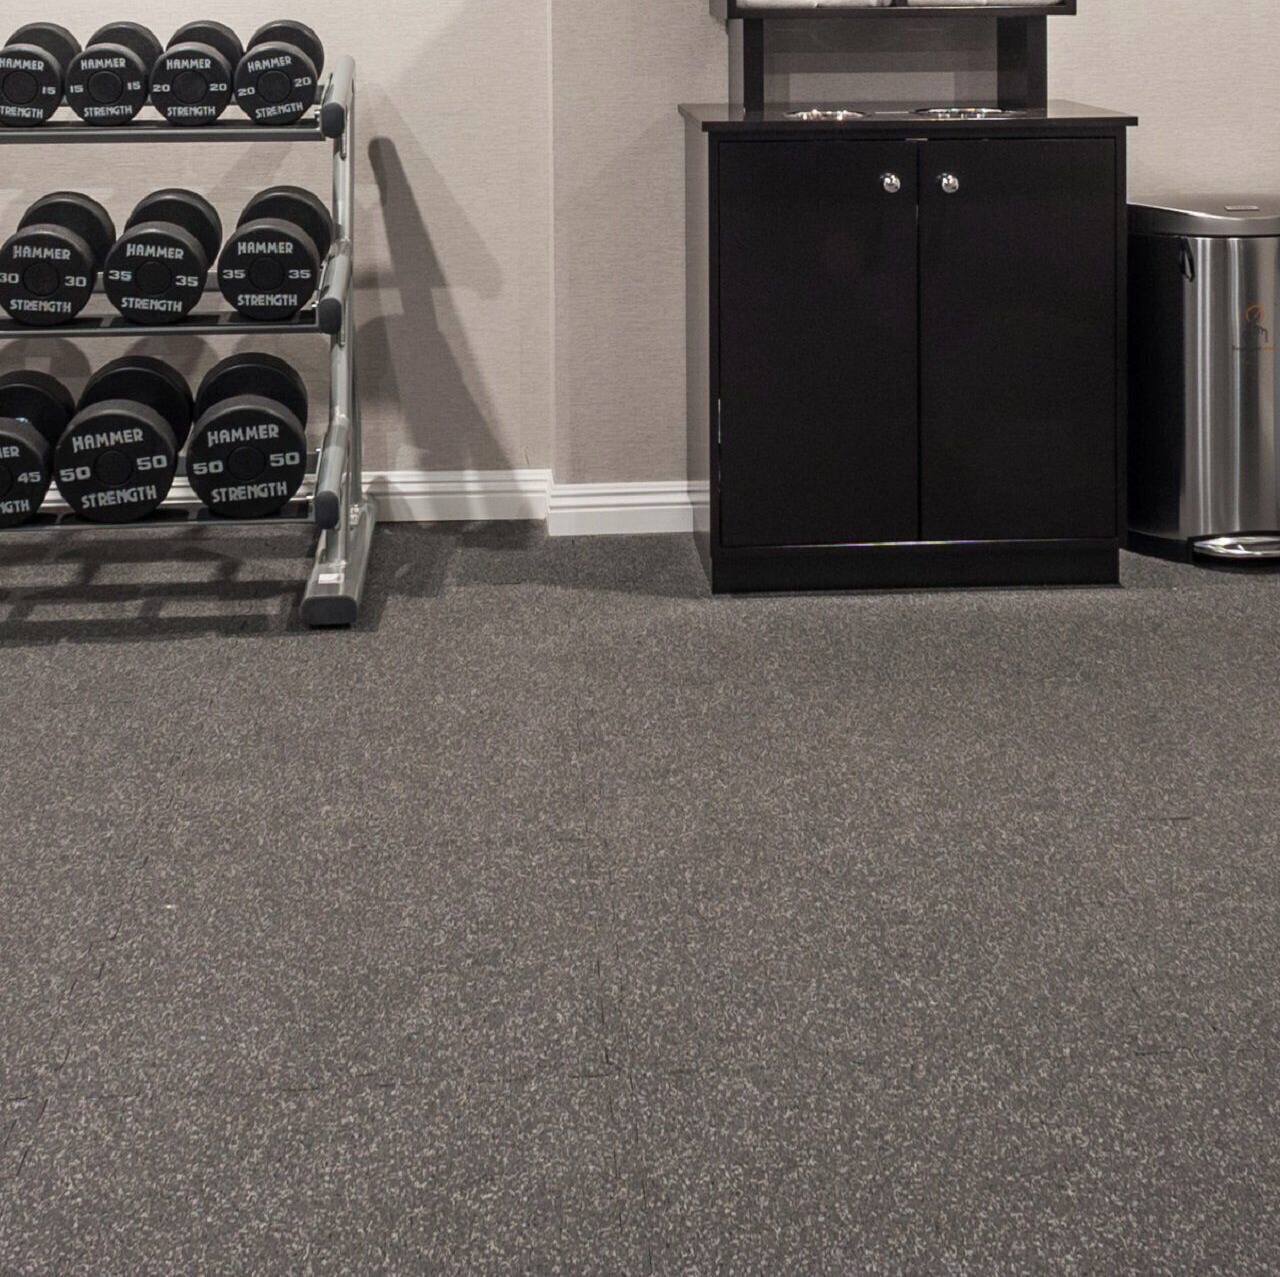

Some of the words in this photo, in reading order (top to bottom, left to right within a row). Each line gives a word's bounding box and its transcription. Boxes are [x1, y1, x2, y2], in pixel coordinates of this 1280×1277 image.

[0, 58, 44, 70] HAMMER
[81, 58, 125, 70] HAMMER
[167, 59, 211, 69] HAMMER
[247, 55, 291, 72] HAMMER
[128, 82, 140, 90] 15
[238, 87, 255, 96] 20
[294, 77, 311, 87] 20
[84, 106, 132, 117] STRENGTH
[168, 106, 215, 116] STRENGTH
[256, 102, 305, 119] STRENGTH
[13, 246, 70, 259] HAMMER
[126, 244, 184, 259] HAMMER
[238, 242, 293, 255] HAMMER
[109, 270, 131, 281] 35
[176, 276, 198, 286] 35
[223, 270, 245, 278] 35
[289, 270, 310, 278] 35
[65, 276, 86, 286] 30
[10, 299, 71, 312] STRENGTH
[121, 297, 182, 311] STRENGTH
[238, 295, 297, 305] STRENGTH
[72, 428, 143, 453] HAMMER
[208, 424, 278, 447] HAMMER
[60, 467, 90, 482] 50
[137, 455, 167, 470] 50
[193, 461, 223, 474] 50
[270, 452, 299, 466] 50
[18, 472, 40, 482] 45
[82, 485, 156, 508] STRENGTH
[212, 482, 287, 502] STRENGTH
